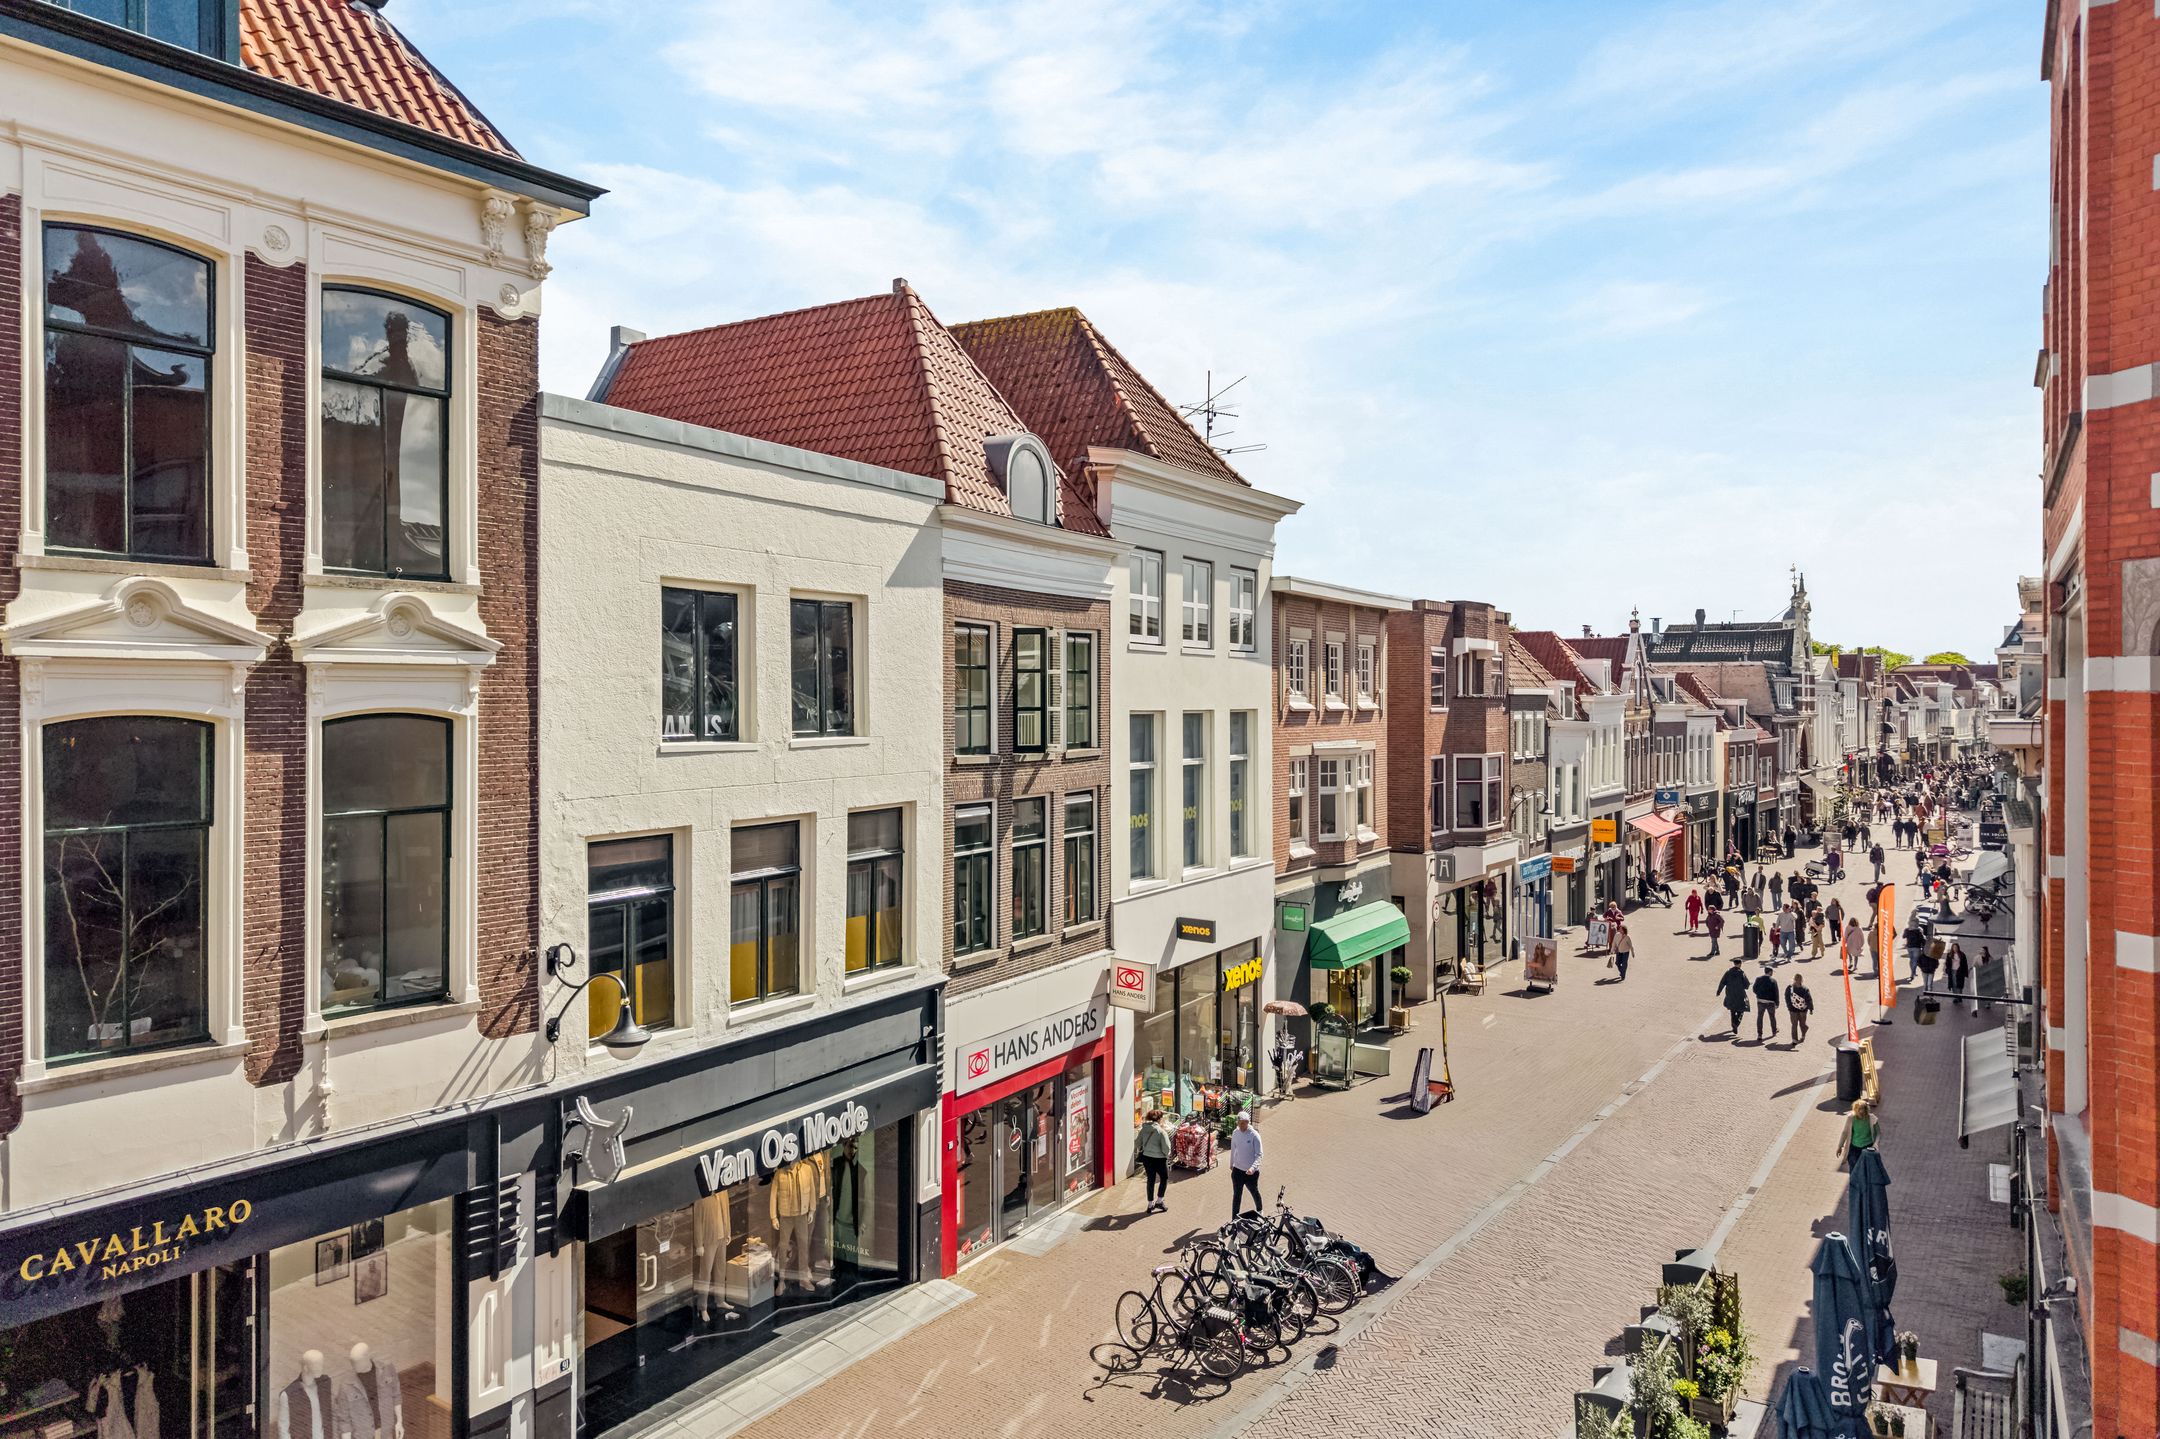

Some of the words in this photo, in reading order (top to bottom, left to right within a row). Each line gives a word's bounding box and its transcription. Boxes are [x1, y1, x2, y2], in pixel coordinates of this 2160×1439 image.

[1182, 924, 1211, 937] xenos
[1225, 956, 1262, 992] xenos
[1112, 988, 1126, 997] HANS
[1126, 991, 1146, 1001] ANDERS
[994, 1030, 1039, 1069] HANS
[1042, 1008, 1097, 1051] ANDERS
[700, 1148, 755, 1193] Van
[760, 1129, 799, 1170] Os
[803, 1100, 869, 1155] Mode
[19, 1199, 253, 1281] CAVALLARO
[102, 1246, 181, 1281] NAPOLI
